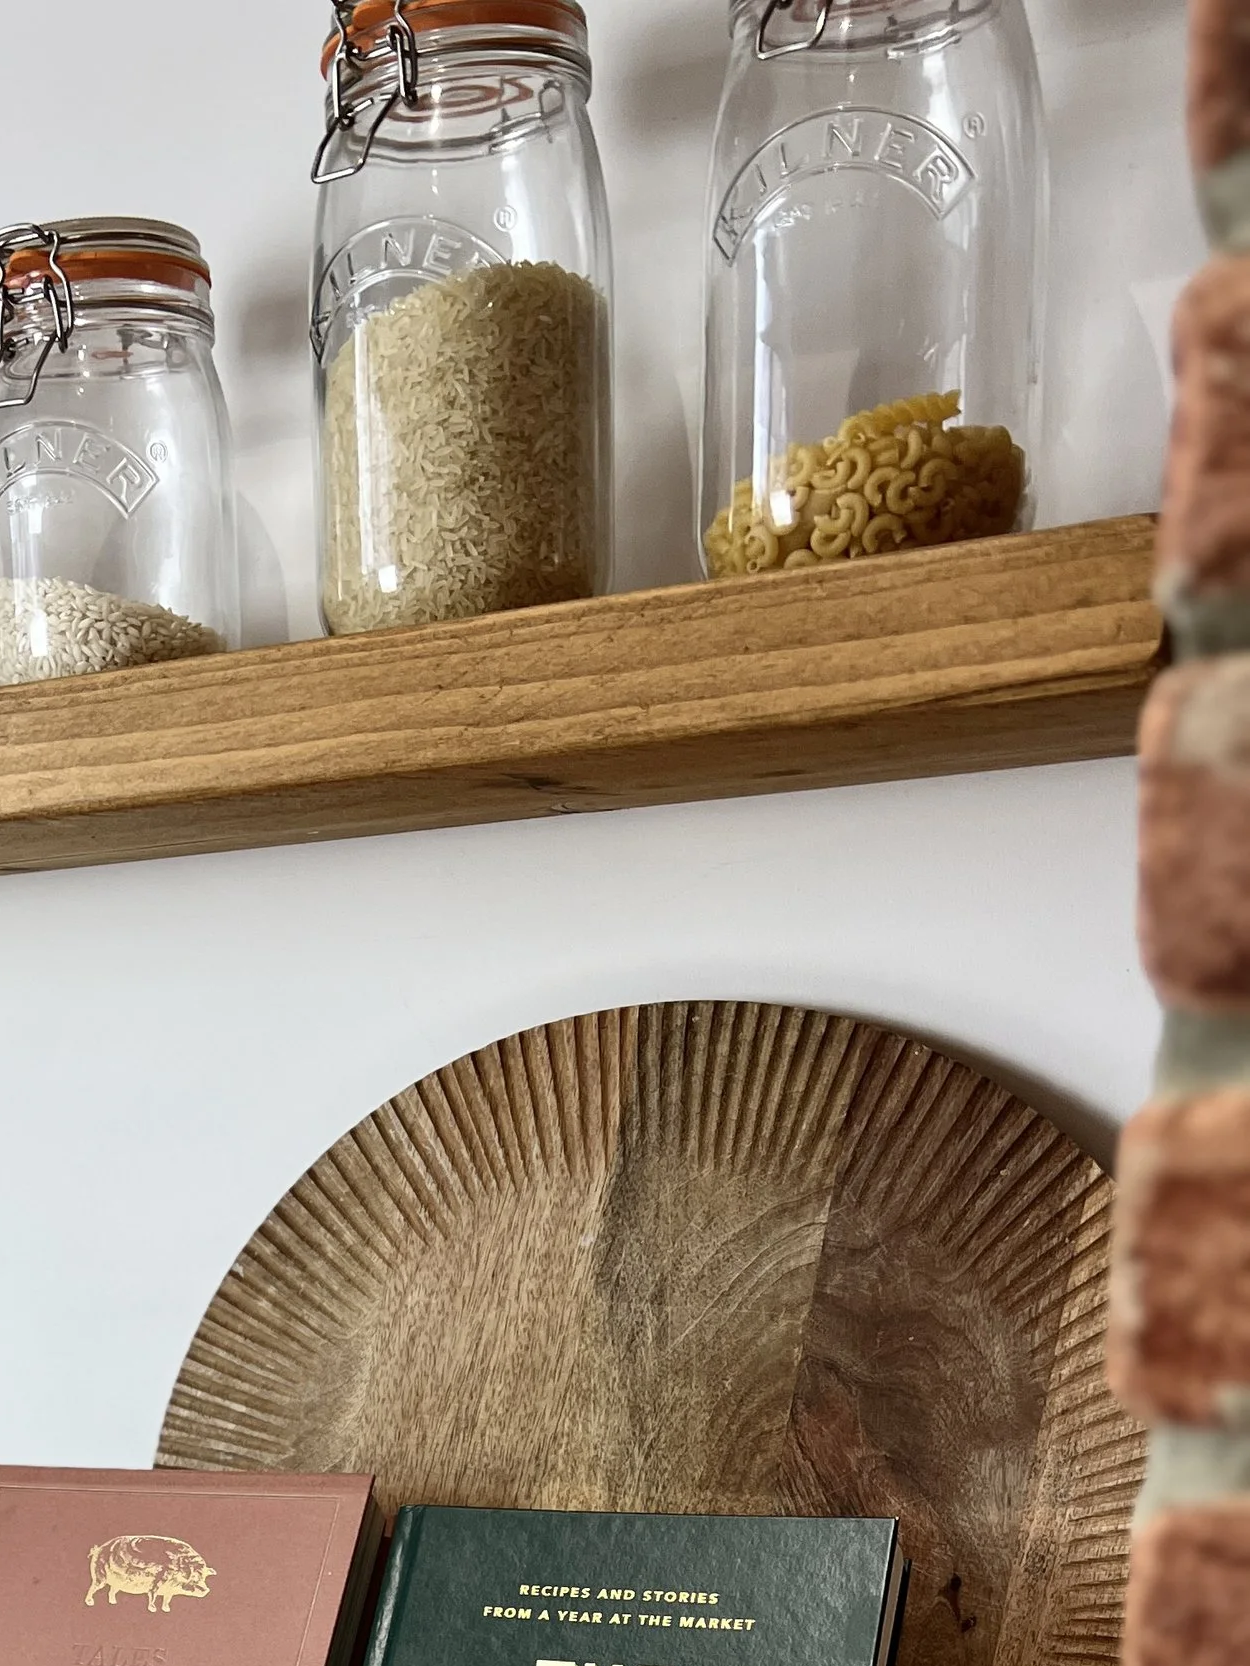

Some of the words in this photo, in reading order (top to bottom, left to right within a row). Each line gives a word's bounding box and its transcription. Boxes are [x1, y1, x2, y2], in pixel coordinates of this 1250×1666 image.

[519, 1584, 592, 1599] RECIPES
[596, 1588, 636, 1601] AND
[642, 1590, 721, 1605] STORIES
[483, 1606, 533, 1620] FROM
[537, 1609, 551, 1621] A
[558, 1610, 603, 1624] YEAR
[609, 1613, 632, 1626] AT
[639, 1614, 673, 1627] THE
[678, 1616, 756, 1631] MARKET
